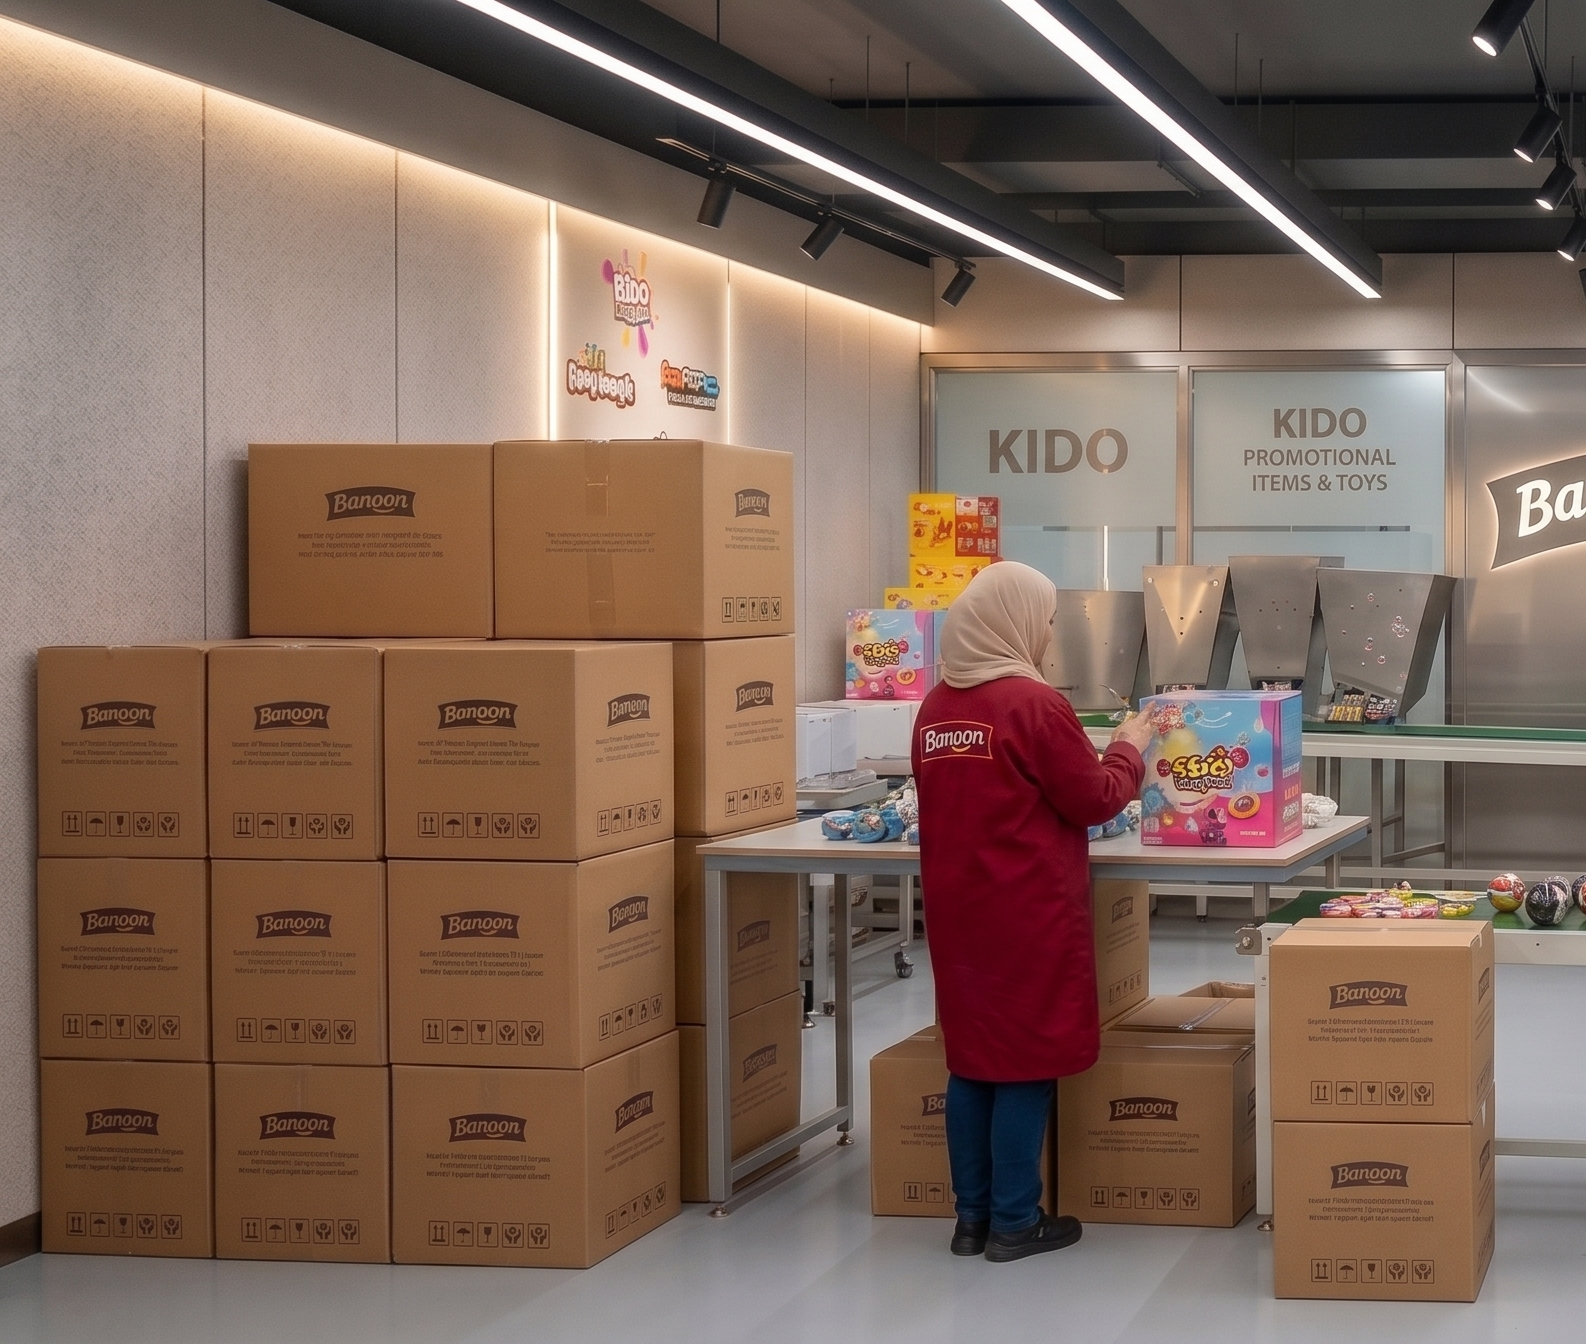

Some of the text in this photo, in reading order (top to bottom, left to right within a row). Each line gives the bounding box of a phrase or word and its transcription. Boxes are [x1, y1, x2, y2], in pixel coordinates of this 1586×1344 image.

[1273, 407, 1367, 438] KIDO
[989, 428, 1128, 474] KIDO
[1244, 448, 1396, 466] PROMOTIONAL
[1252, 474, 1388, 492] ITEMS & TOYS
[334, 492, 408, 514] Banoon
[86, 706, 152, 725] Banoon
[259, 706, 325, 725] Banoon
[444, 704, 511, 724] Banoon
[925, 729, 985, 753] Banoon
[86, 913, 150, 931] Banoon
[262, 916, 326, 933] Banoon
[448, 916, 513, 934] Banoon
[1335, 986, 1403, 1004] Banoon
[1114, 1101, 1174, 1117] Banoon
[91, 1112, 154, 1130] Banoon
[265, 1116, 330, 1135] Banoon
[455, 1117, 521, 1137] Banoon
[1336, 1166, 1403, 1184] Banoon
